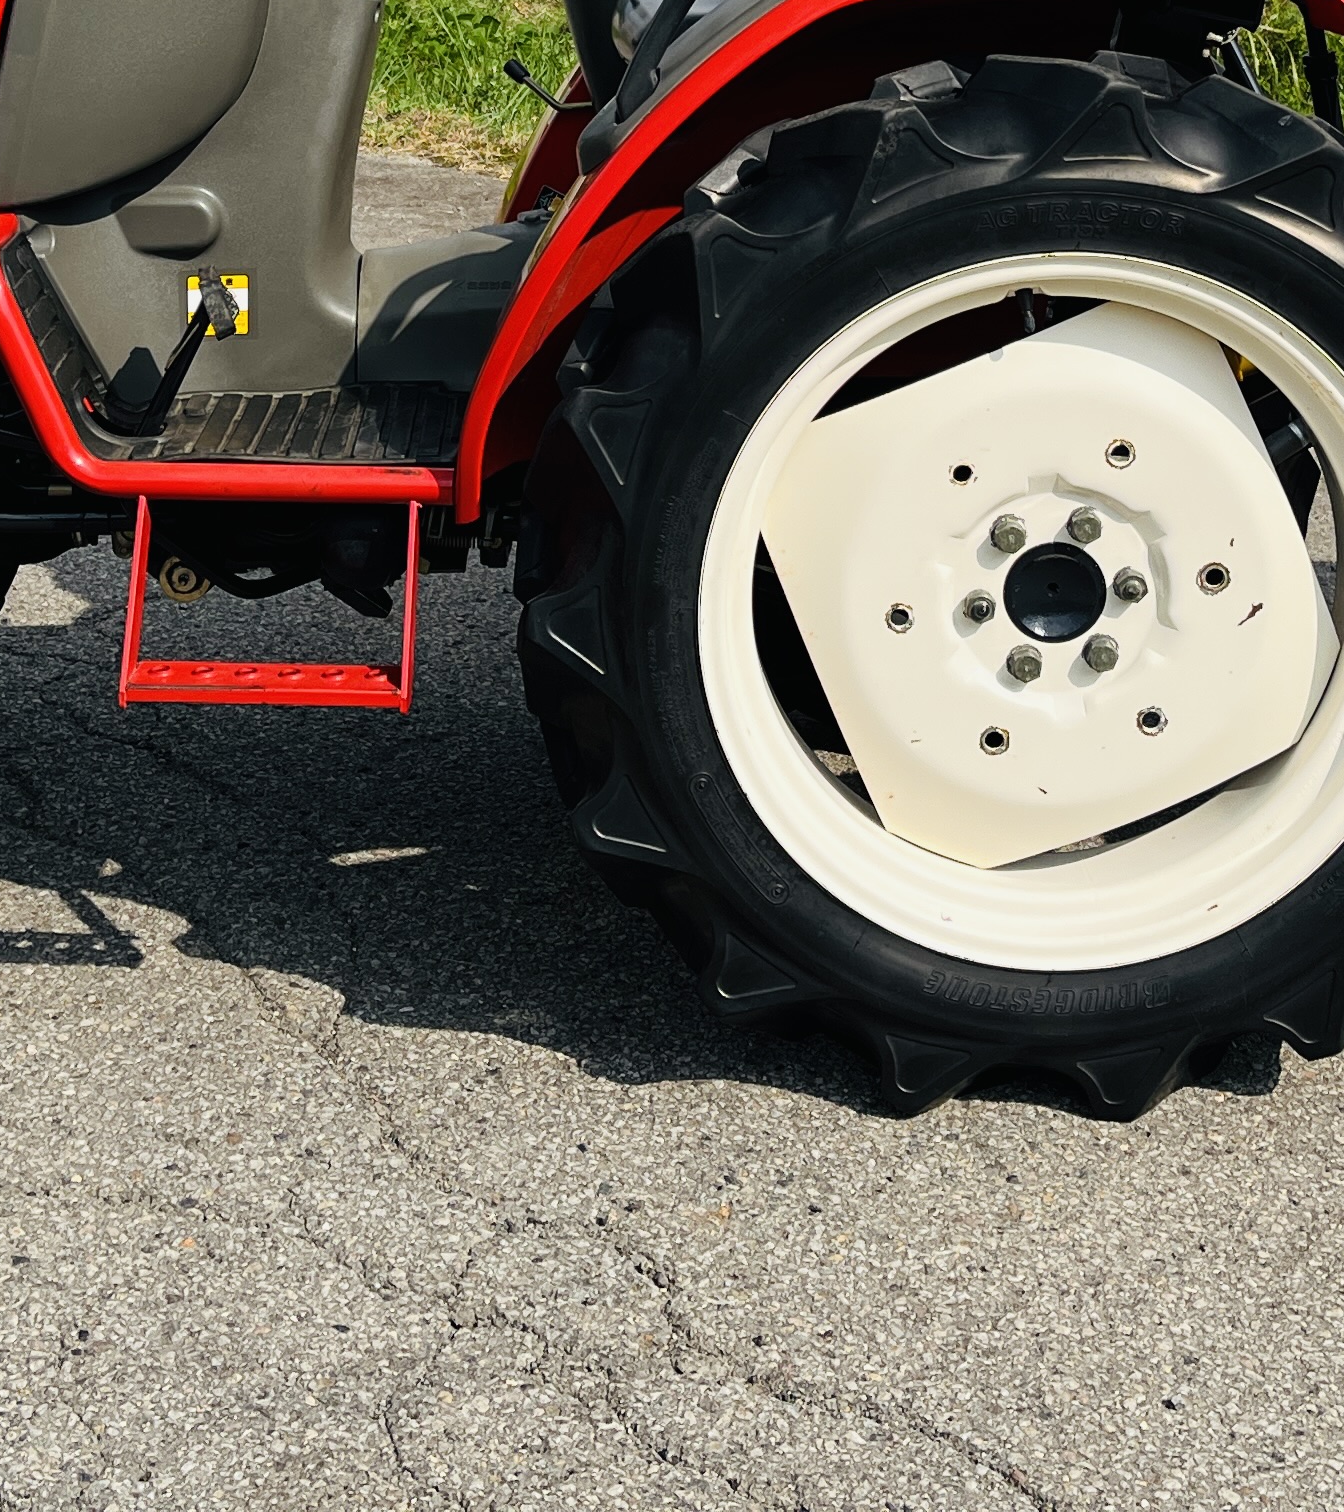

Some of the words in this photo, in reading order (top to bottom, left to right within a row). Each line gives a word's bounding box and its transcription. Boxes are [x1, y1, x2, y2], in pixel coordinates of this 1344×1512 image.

[976, 205, 1018, 232] AG
[1026, 200, 1185, 235] TRACTOR
[921, 969, 1173, 1015] BRIDGESTONE
